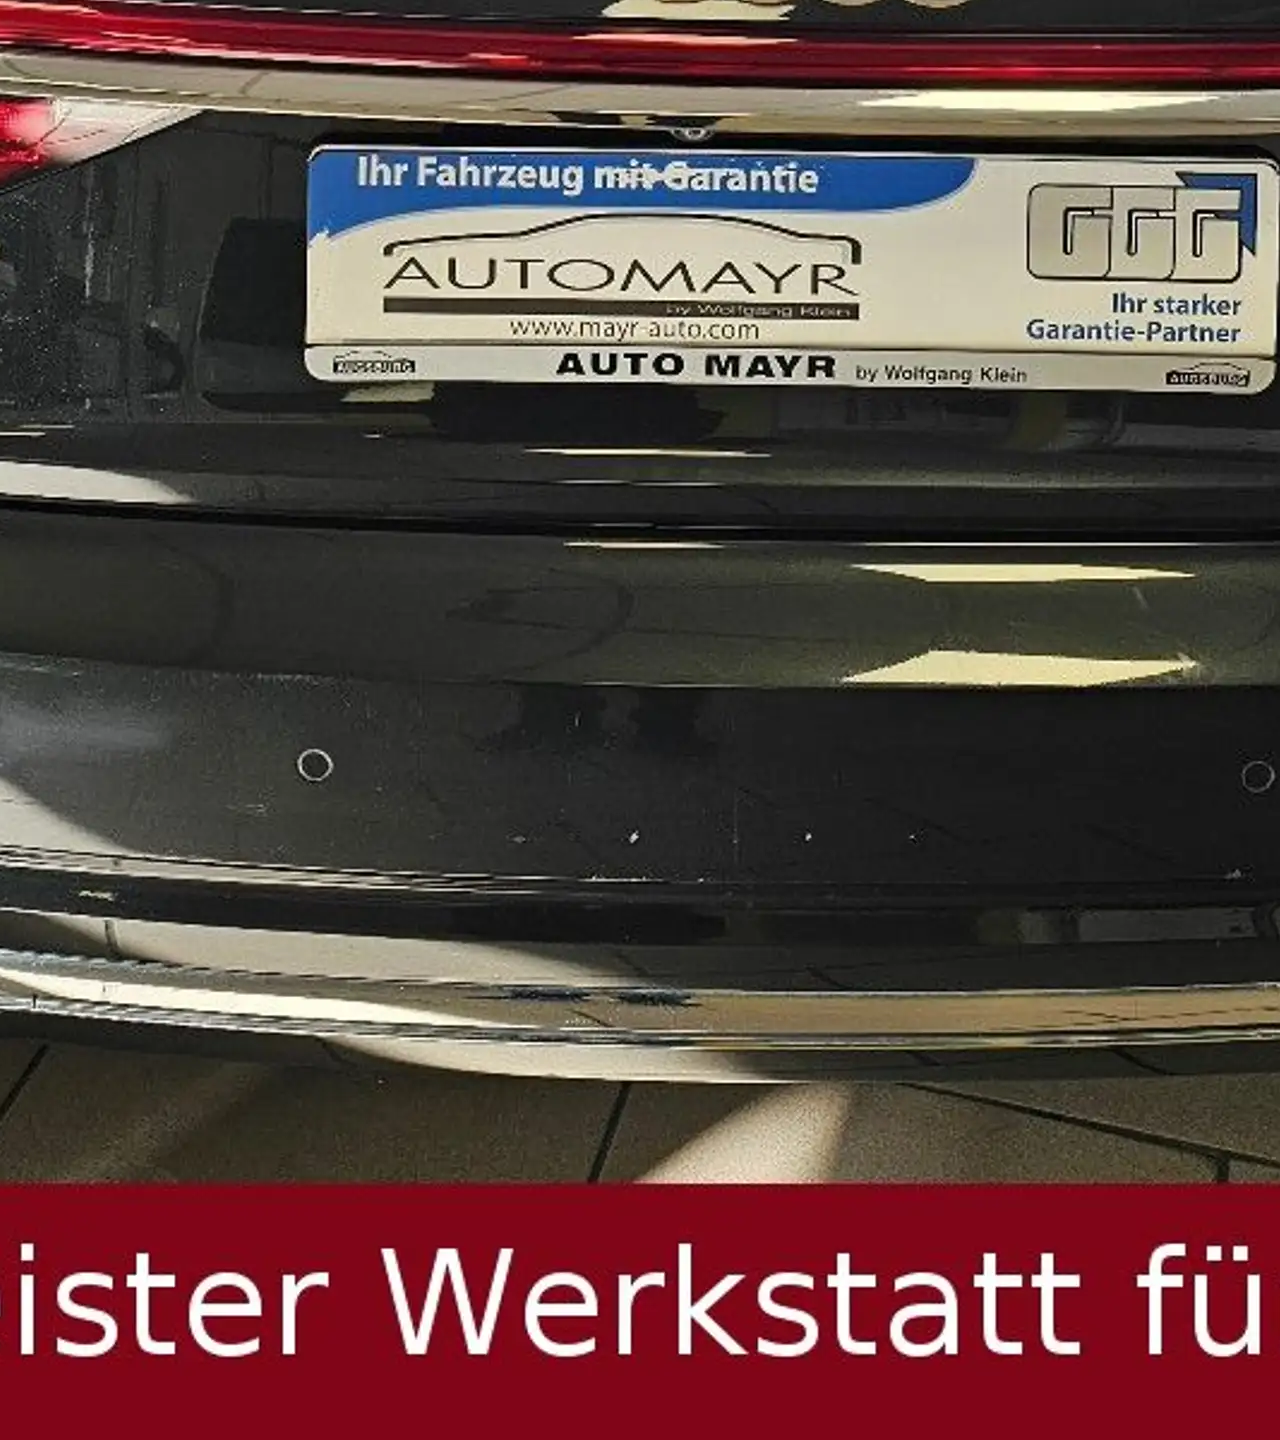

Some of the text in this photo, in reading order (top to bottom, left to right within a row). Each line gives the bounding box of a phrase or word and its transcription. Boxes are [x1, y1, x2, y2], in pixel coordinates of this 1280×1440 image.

[358, 155, 408, 187] Ihr
[417, 156, 583, 196] Fahrzeug
[663, 160, 819, 194] Garantie
[383, 257, 860, 297] AUTOMAYR
[697, 303, 793, 319] Wolfgang
[800, 305, 851, 318] Klein
[1112, 292, 1243, 317] Ihr starker
[509, 318, 761, 342] www.mayr-auto.com
[1026, 319, 1241, 344] Garantie-Partner
[557, 352, 1028, 385] AUTO MAYR by Wolfgang Klein
